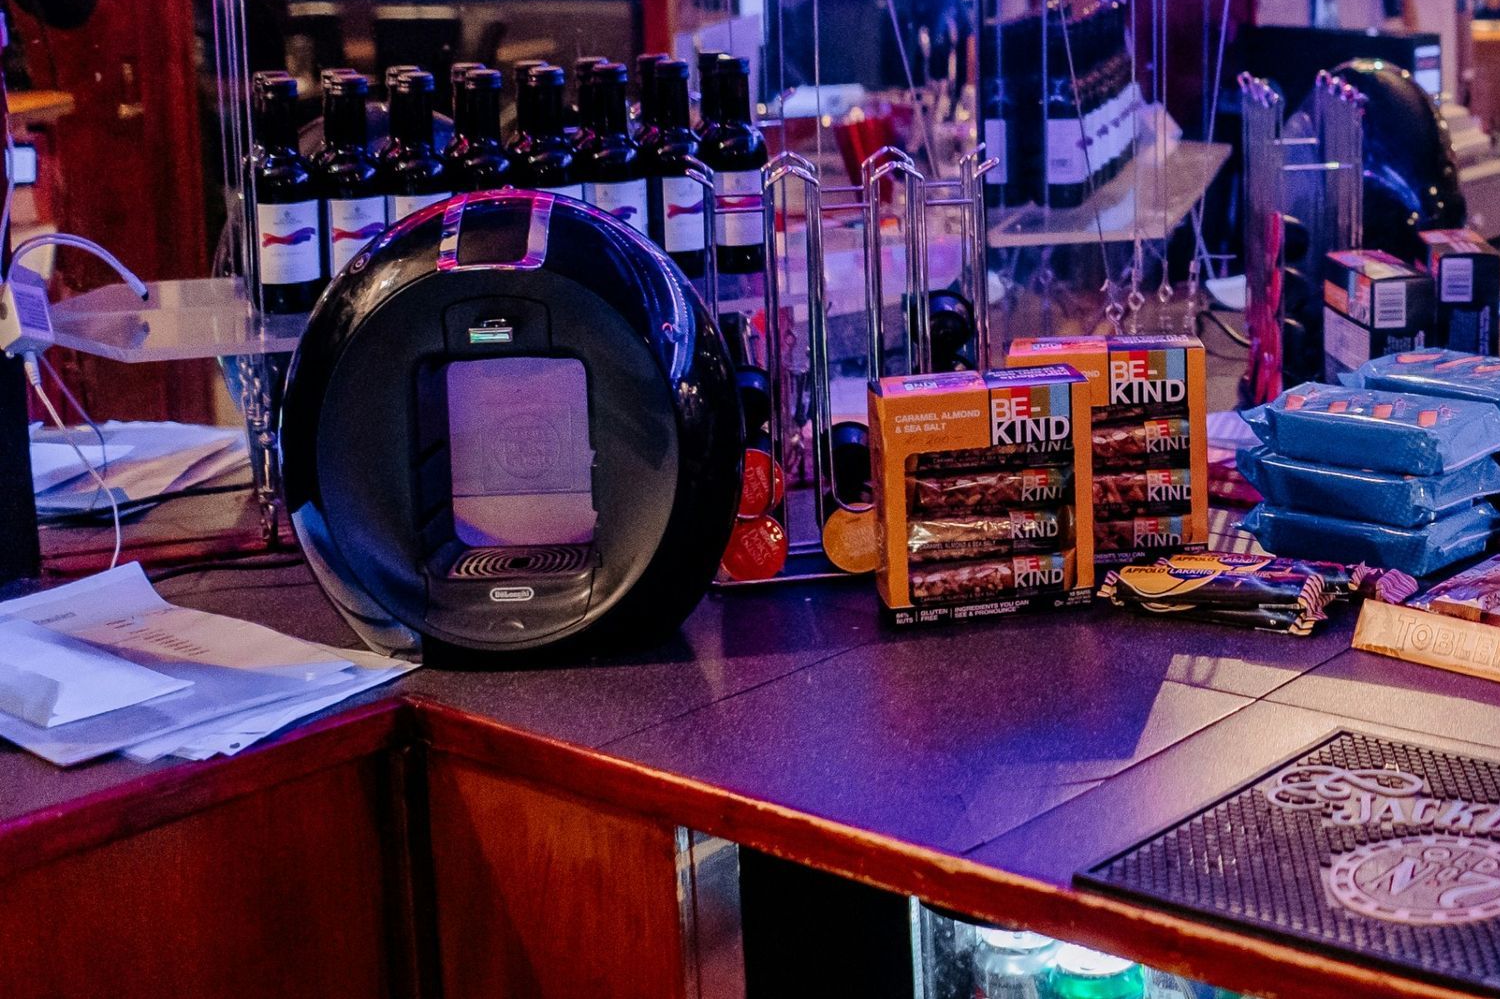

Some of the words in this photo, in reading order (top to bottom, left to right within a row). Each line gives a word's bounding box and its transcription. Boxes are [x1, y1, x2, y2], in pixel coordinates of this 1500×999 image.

[1111, 360, 1158, 382] BE-
[1111, 379, 1186, 405] KIND
[895, 411, 939, 424] CARAMEL
[941, 408, 981, 421] ALMOND
[991, 396, 1041, 422] BE-
[904, 423, 922, 433] SEA
[924, 422, 946, 431] SALT
[991, 416, 1070, 446] KIND
[1022, 487, 1062, 501] KIN
[1011, 521, 1058, 539] KIND
[1134, 533, 1182, 548] KIND
[1015, 569, 1064, 589] KIND
[920, 608, 948, 617] GLUTEN
[955, 603, 999, 613] INGREDIENTS
[1012, 600, 1029, 608] CAN
[975, 607, 1017, 617] PRONOUNCE
[1423, 847, 1499, 874] OLD
